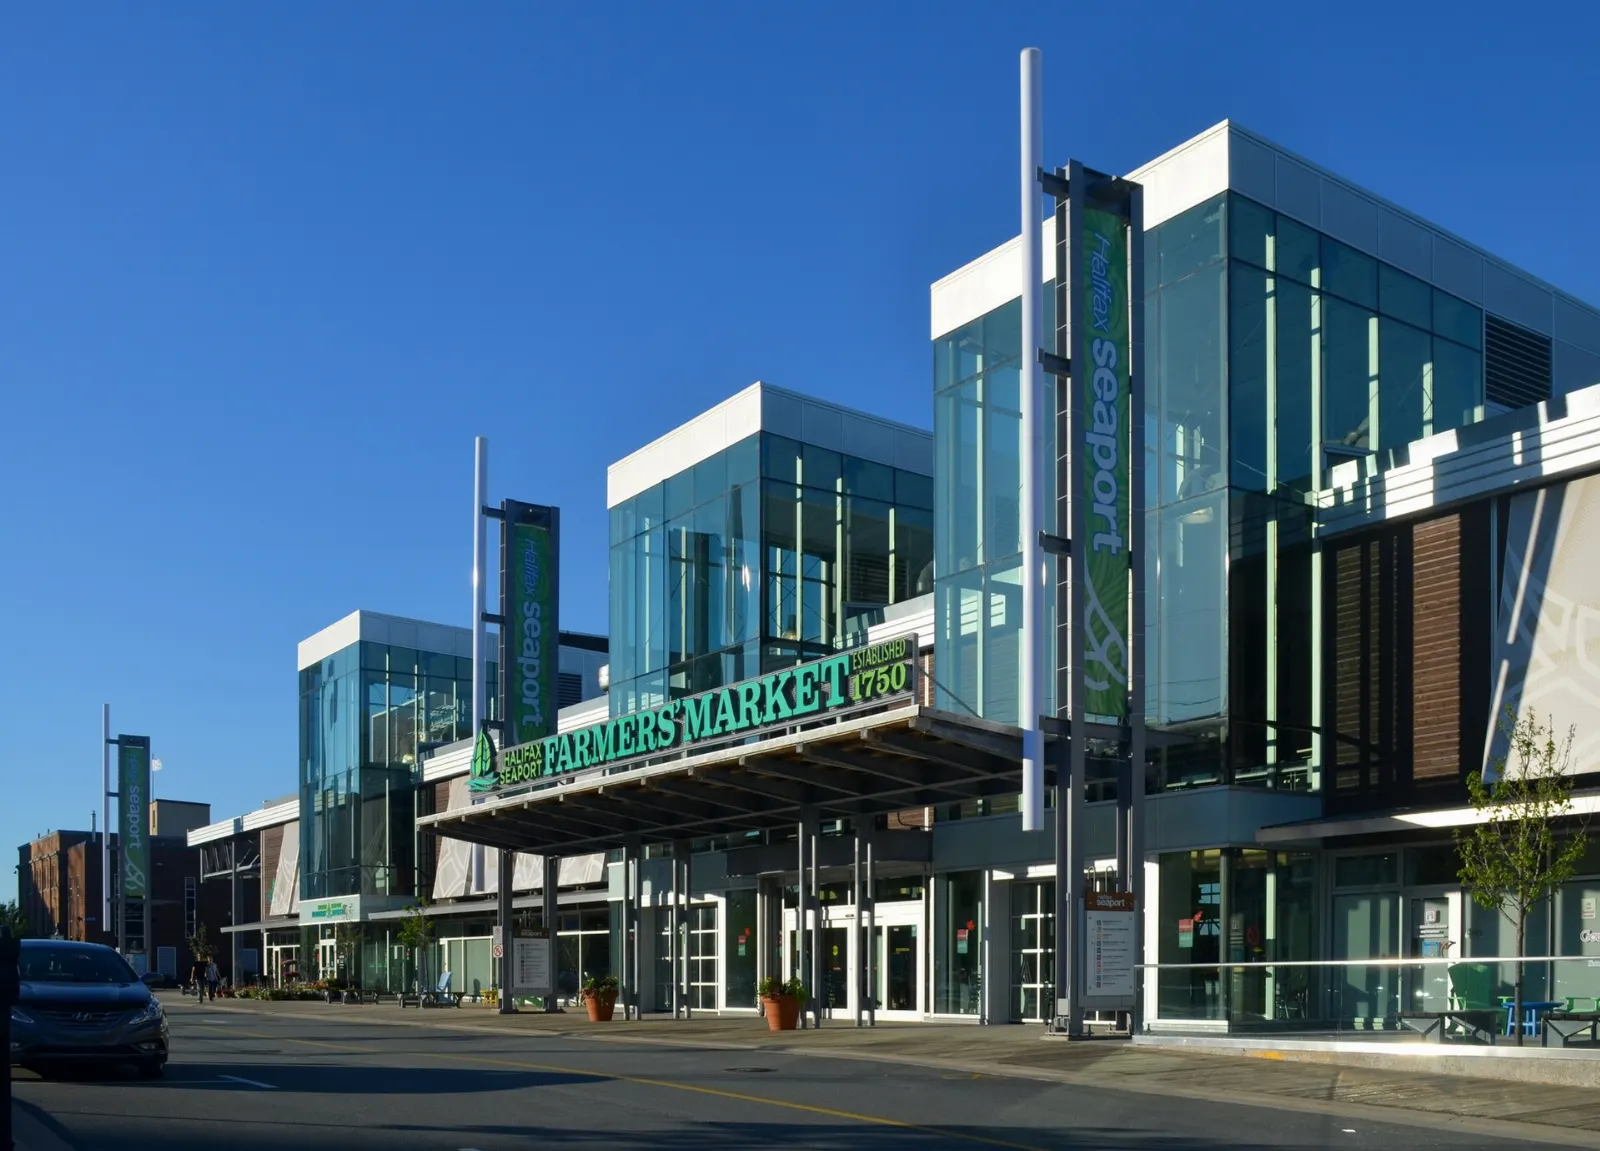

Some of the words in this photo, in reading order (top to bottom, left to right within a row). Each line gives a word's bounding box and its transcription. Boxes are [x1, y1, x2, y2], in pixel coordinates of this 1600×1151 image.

[1091, 231, 1112, 333] Halifax
[1085, 337, 1122, 555] seaport
[524, 538, 539, 598] Halifax
[517, 600, 543, 728] seaport
[852, 638, 906, 671] ESTABLISHED
[852, 661, 906, 701] 1750
[543, 698, 681, 776] FARMERS'
[682, 653, 849, 742] MARKET
[500, 759, 543, 785] SEAPORT
[503, 743, 542, 766] HALIFAX
[127, 784, 142, 849] seaport
[1096, 899, 1126, 908] seaport
